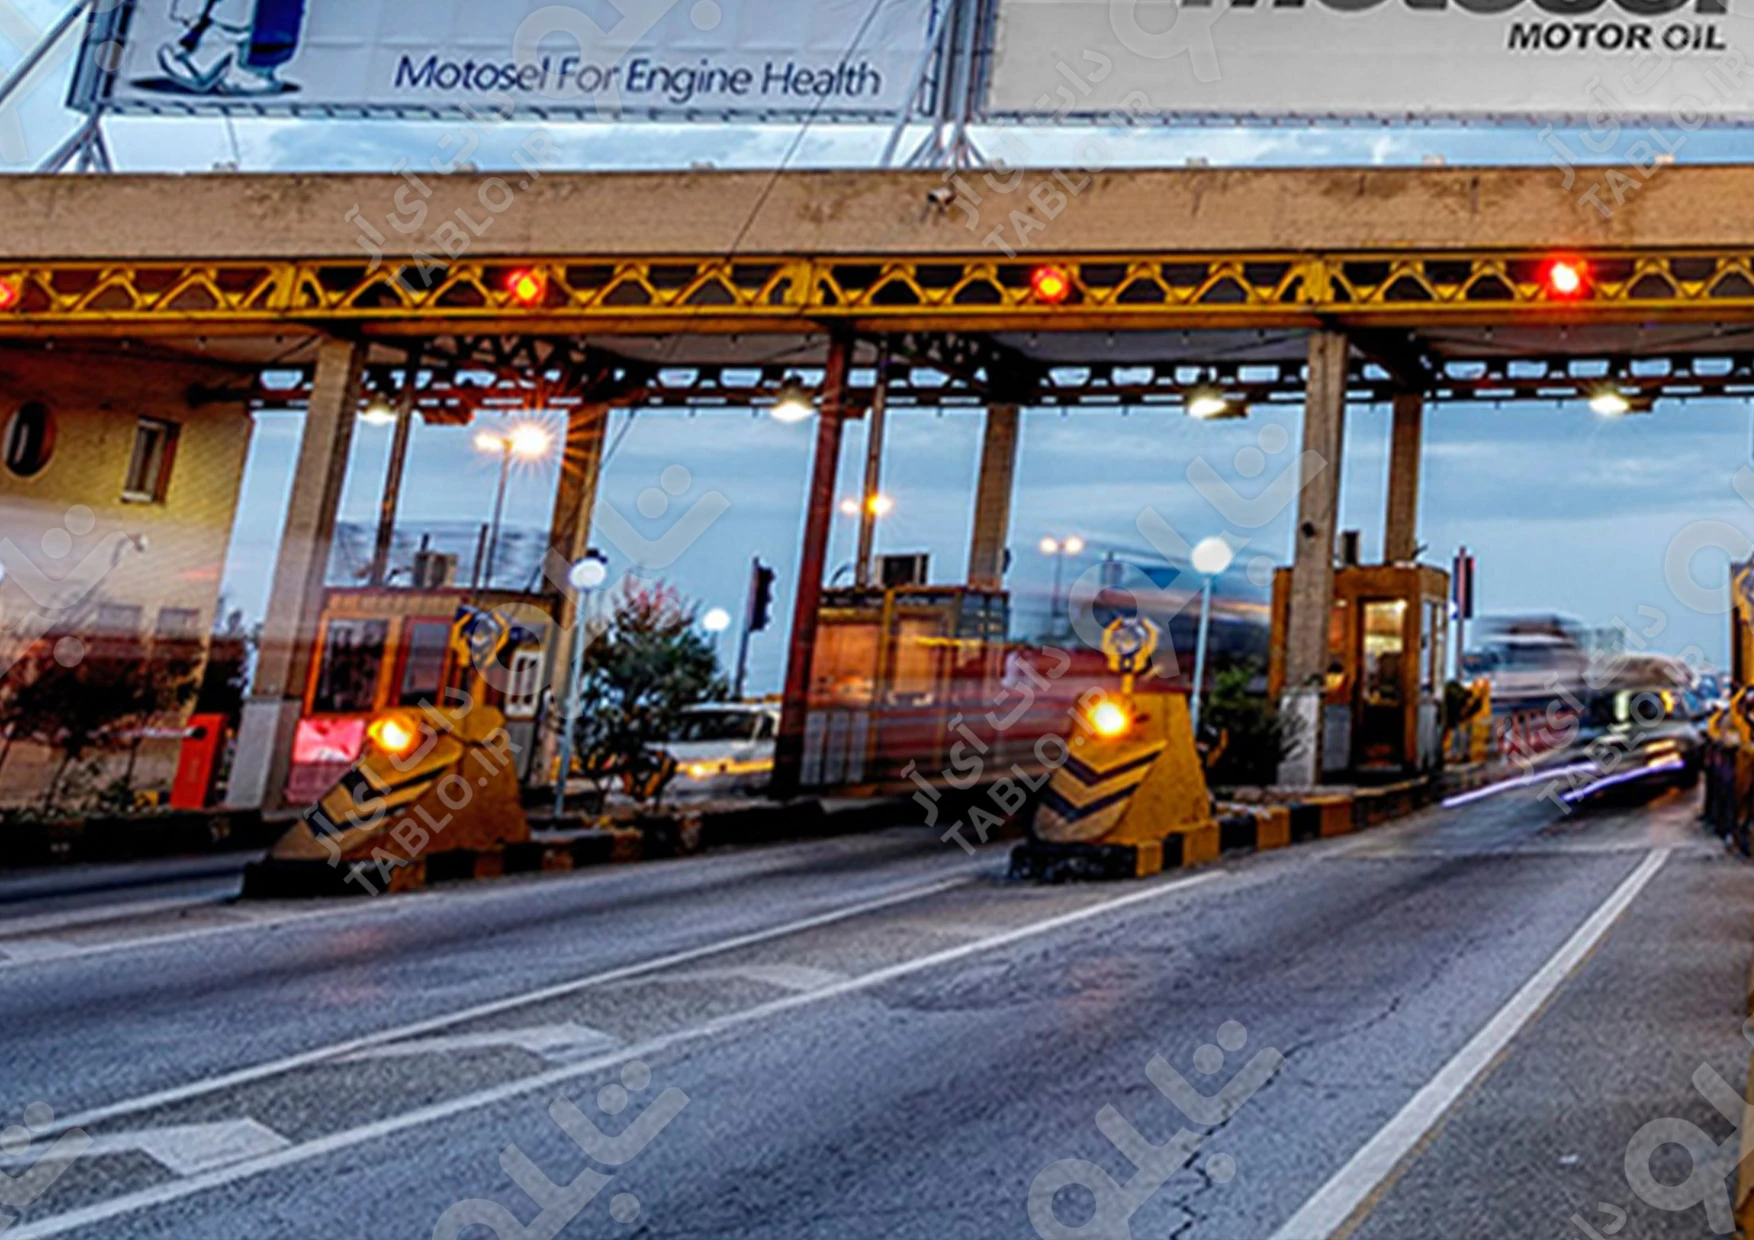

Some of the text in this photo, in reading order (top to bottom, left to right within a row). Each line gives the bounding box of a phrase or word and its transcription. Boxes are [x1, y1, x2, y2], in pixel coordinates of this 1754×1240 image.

[1507, 23, 1727, 50] MOTOR OIL
[394, 54, 880, 105] Motosel For Engine Health
